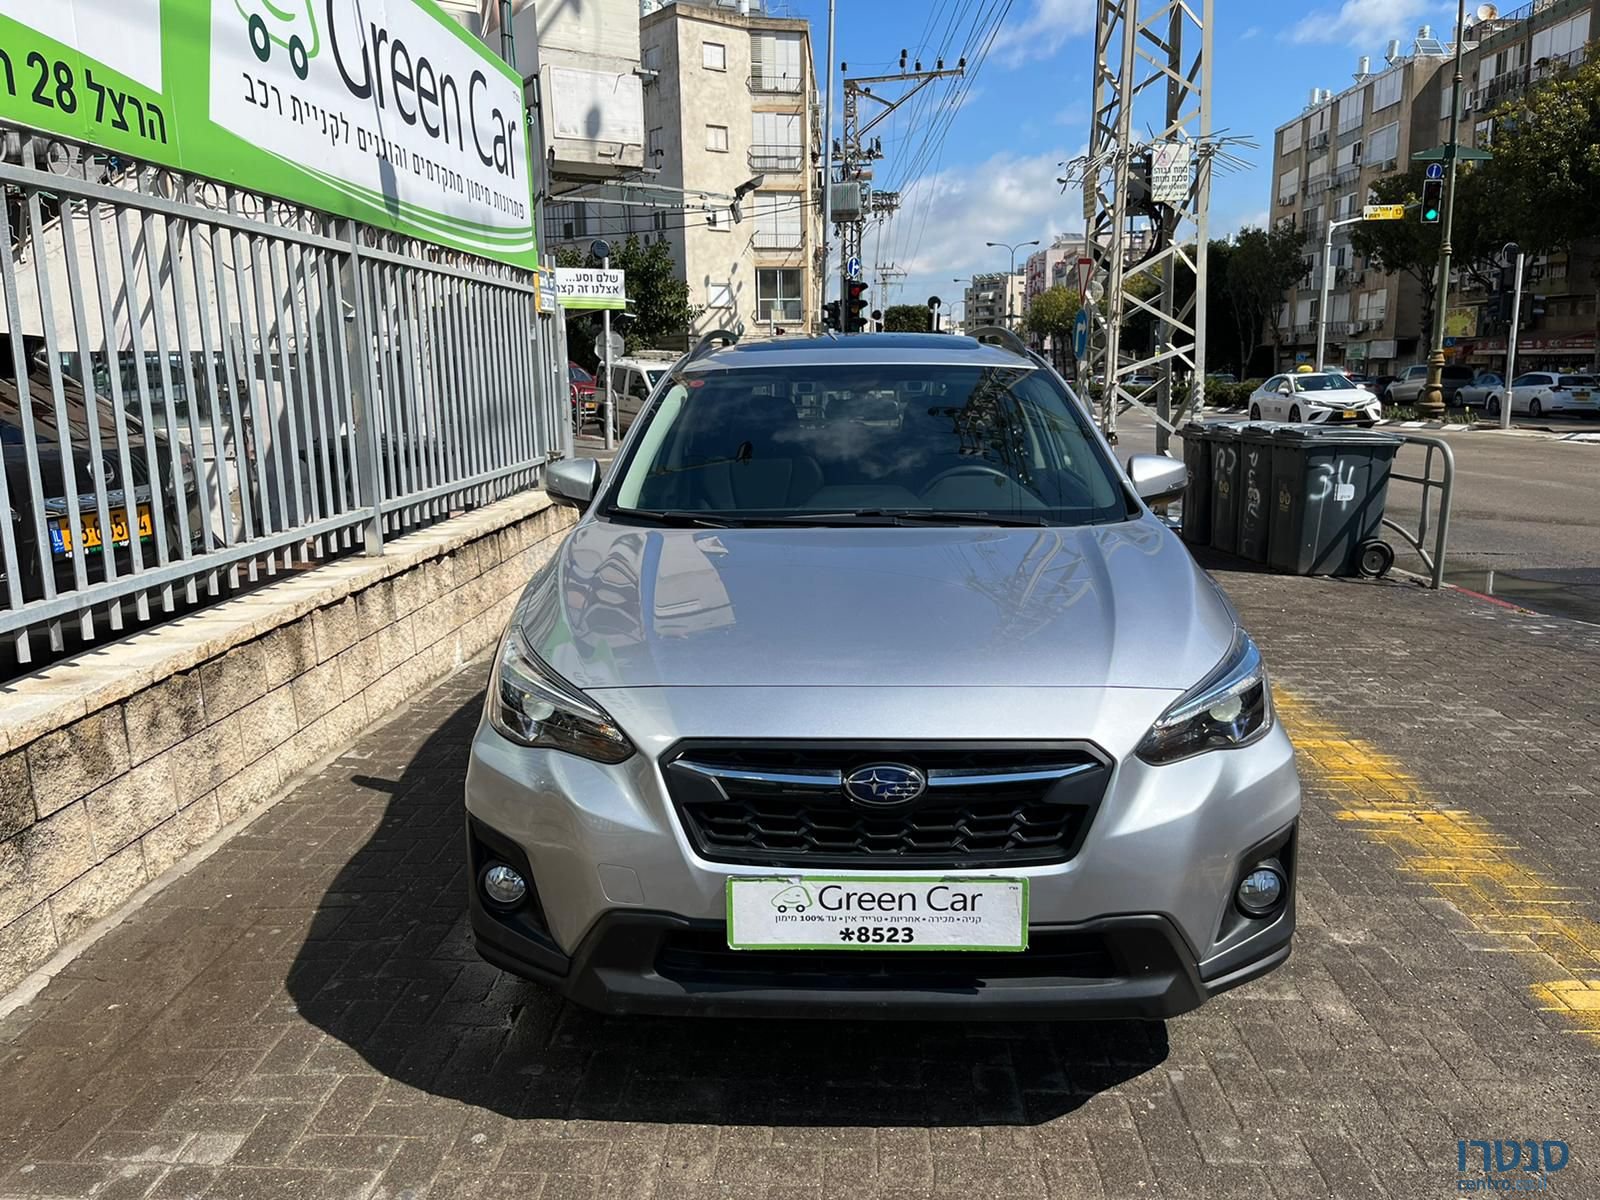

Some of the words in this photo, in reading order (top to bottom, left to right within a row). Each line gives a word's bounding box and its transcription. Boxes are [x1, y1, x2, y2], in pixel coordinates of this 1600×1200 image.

[27, 51, 77, 114] 28
[242, 72, 283, 116] רכב
[326, 0, 464, 152] Green
[469, 70, 517, 180] Car
[85, 68, 167, 144] הרצל
[290, 94, 349, 147] לקניית
[356, 126, 408, 170] והוגנים
[412, 152, 464, 195] מתקדמים
[466, 178, 491, 206] מימון
[493, 190, 525, 220] פתרונות
[577, 285, 589, 294] זה
[591, 284, 619, 294] אצלנו
[596, 272, 619, 283] שלם
[818, 885, 916, 912] Green
[926, 885, 983, 912] Car
[775, 915, 798, 924] מימון
[844, 915, 857, 924] אין
[861, 915, 883, 923] טרייד
[890, 915, 921, 923] אחריות
[928, 915, 955, 923] מכירה
[962, 915, 982, 925] קניה
